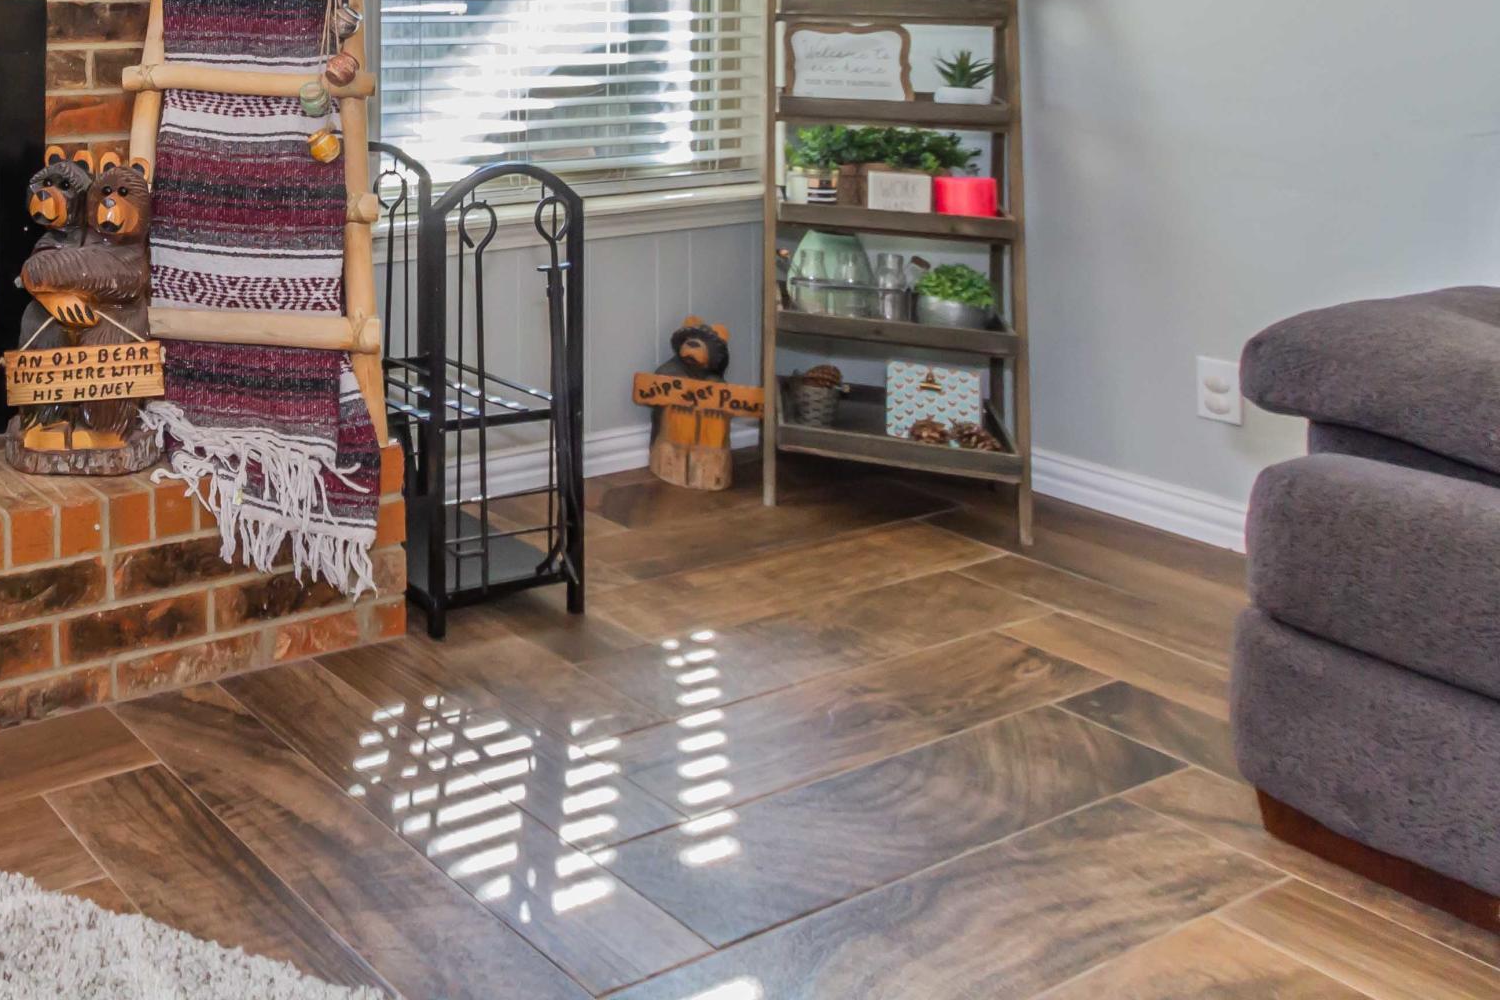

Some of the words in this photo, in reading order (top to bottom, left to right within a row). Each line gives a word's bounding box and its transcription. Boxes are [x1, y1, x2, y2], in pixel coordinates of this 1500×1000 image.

[17, 354, 42, 368] AN
[51, 350, 88, 367] OLD
[97, 346, 150, 364] BEAR
[13, 370, 55, 385] LIVES
[62, 366, 106, 381] HERE
[111, 363, 155, 378] WITH
[33, 388, 64, 401] HIS
[73, 381, 135, 400] HONEY
[719, 389, 764, 412] Paw
